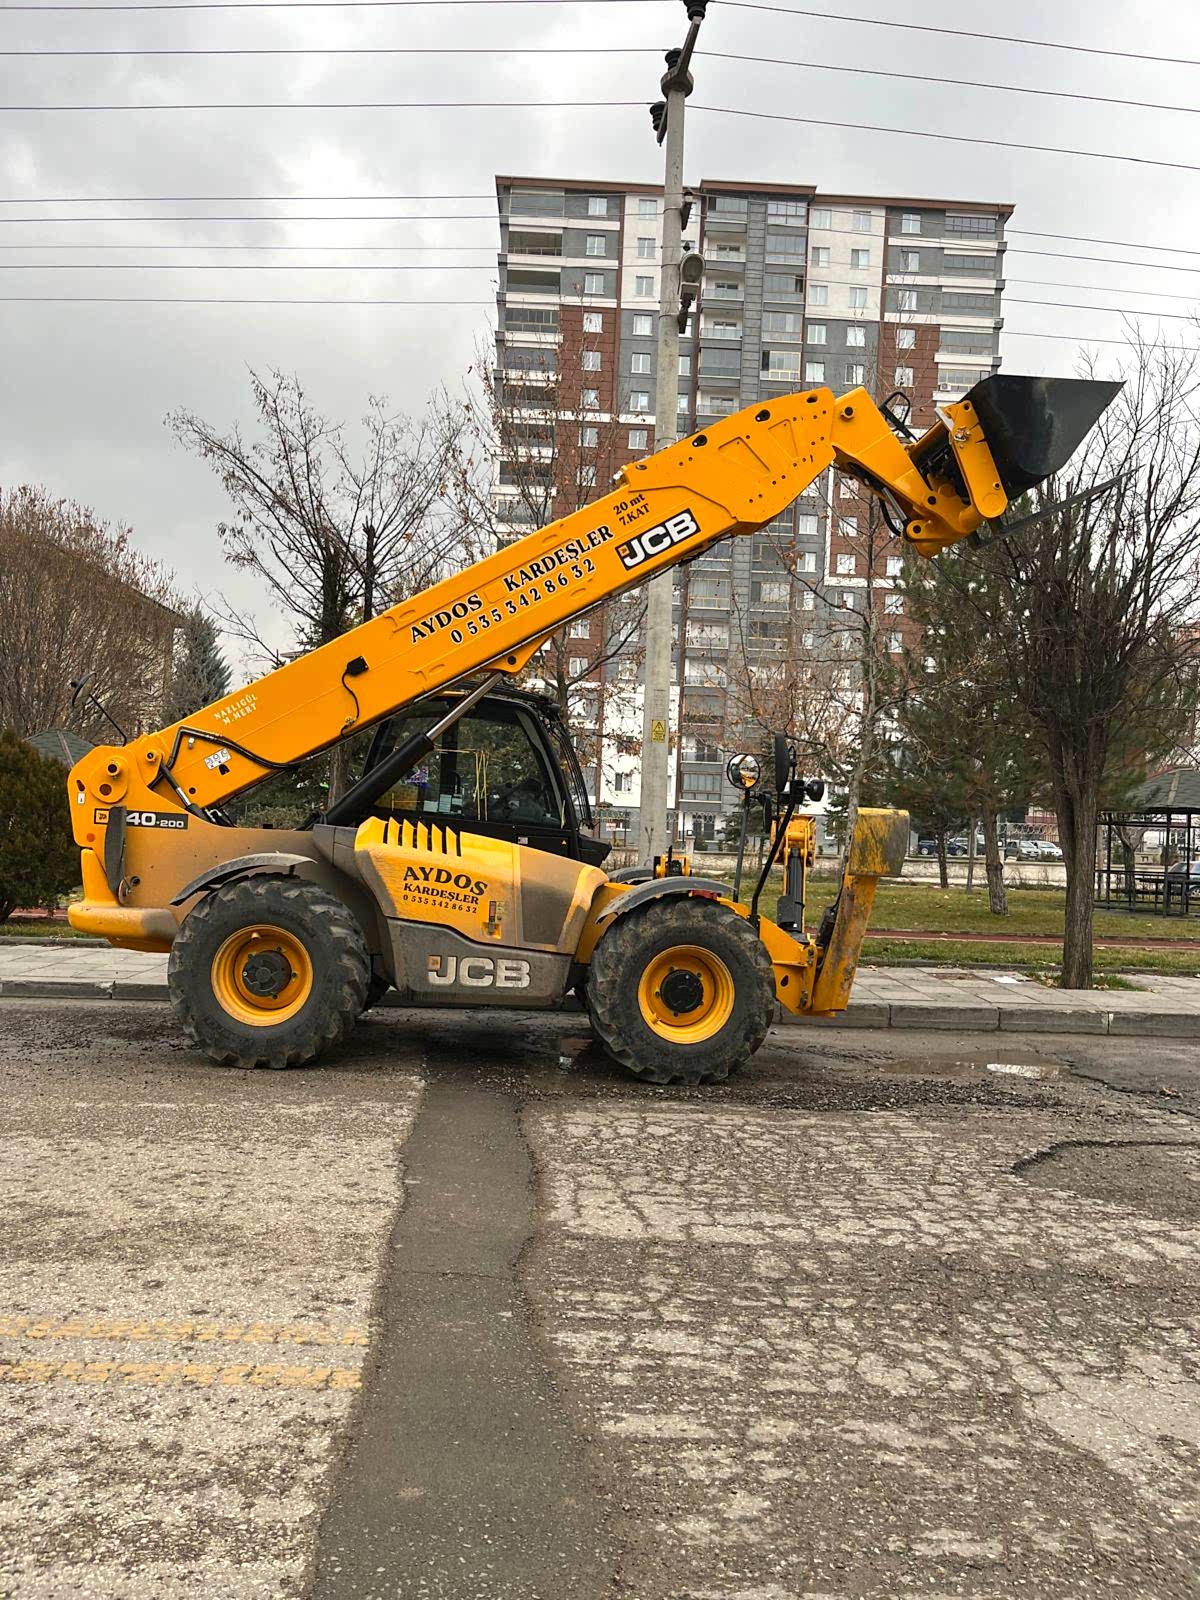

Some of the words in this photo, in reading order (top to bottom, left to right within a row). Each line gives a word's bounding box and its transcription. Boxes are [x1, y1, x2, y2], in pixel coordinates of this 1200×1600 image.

[613, 501, 629, 515] 20
[629, 493, 646, 507] mt
[619, 503, 650, 526] 7.KAT
[623, 512, 697, 567] JCB
[411, 594, 483, 643] AYDOS
[503, 525, 614, 592] KARDEŞLER
[451, 629, 463, 643] 0
[467, 608, 502, 635] 535
[505, 588, 542, 614] 342
[571, 558, 595, 578] 32
[213, 693, 258, 721] NAZLIGÜL
[125, 812, 185, 828] 40-200
[403, 866, 488, 896] AYDOS
[403, 883, 479, 905] KARDEŞLER
[411, 896, 429, 905] 535
[431, 899, 449, 909] 342
[465, 906, 477, 914] 32
[428, 956, 531, 988] JCB
